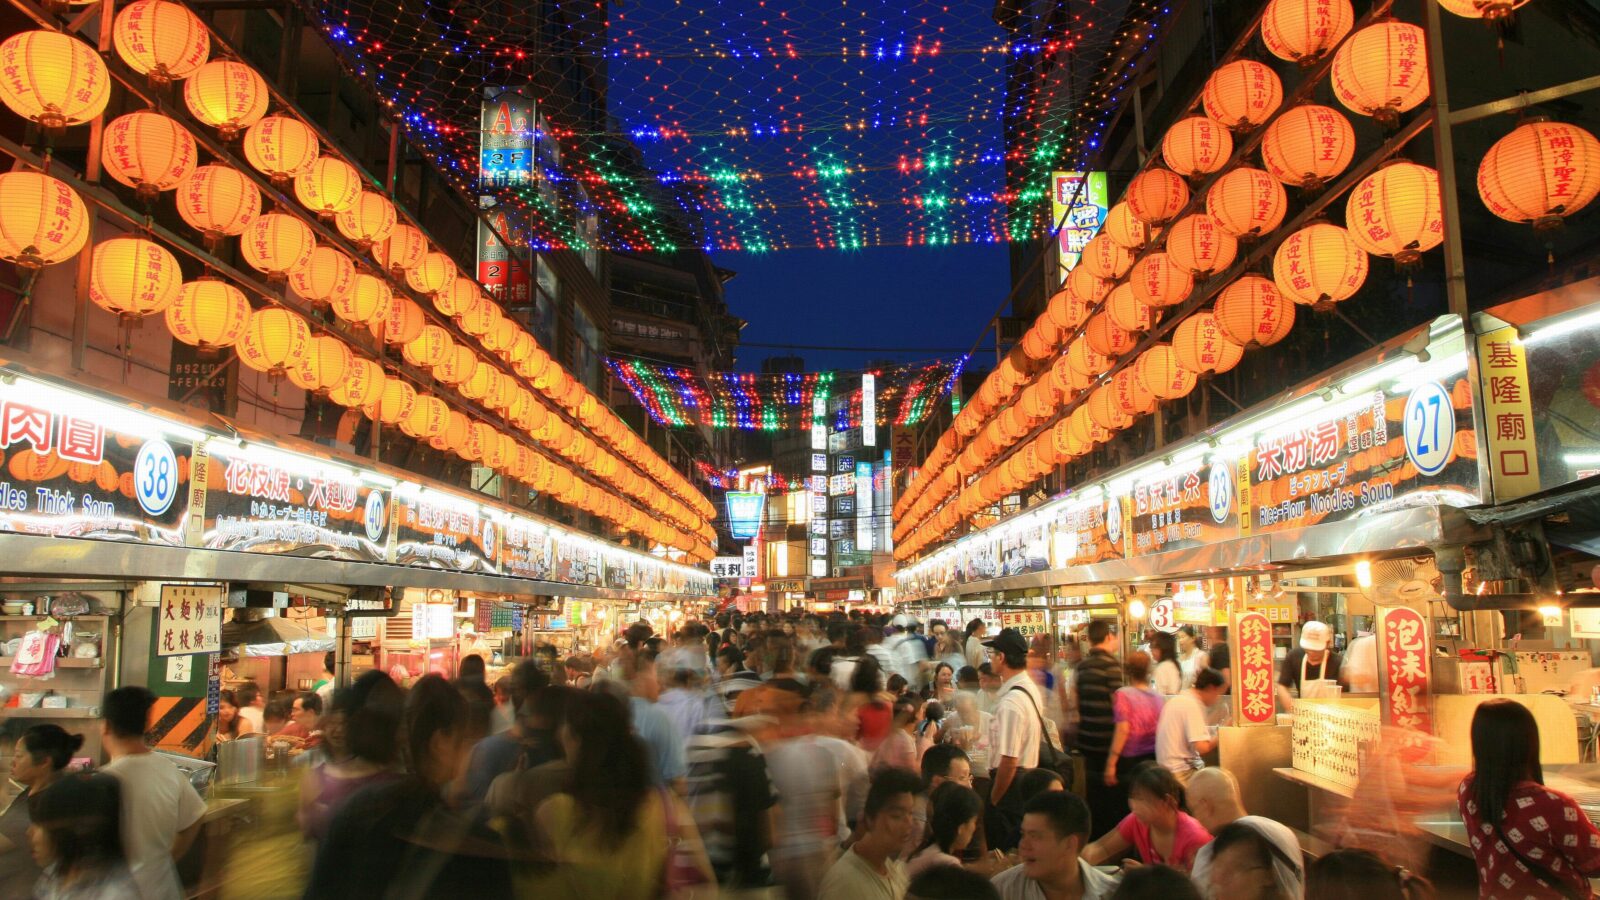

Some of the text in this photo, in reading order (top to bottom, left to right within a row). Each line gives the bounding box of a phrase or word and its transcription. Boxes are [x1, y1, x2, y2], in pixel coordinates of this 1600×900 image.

[1390, 33, 1418, 88] 開漳聖王
[1317, 113, 1338, 162] 開漳聖王
[1548, 136, 1577, 198] 開漳聖王
[1359, 177, 1392, 242] 歡迎光臨
[1287, 233, 1312, 290] 歡迎光臨
[1258, 282, 1279, 336] 歡迎光臨
[1, 400, 106, 463] 肉圓
[1413, 394, 1441, 457] 27
[1486, 341, 1530, 477] 基隆廟口
[142, 452, 171, 502] 38
[1257, 420, 1341, 481] 米粉湯
[36, 485, 77, 515] Thick
[83, 495, 116, 521] Soup
[369, 499, 383, 532] 40
[1213, 471, 1228, 511] 23
[1259, 480, 1395, 527] Rice-Flour Noodles Soup
[1241, 618, 1273, 716] 珍珠奶茶
